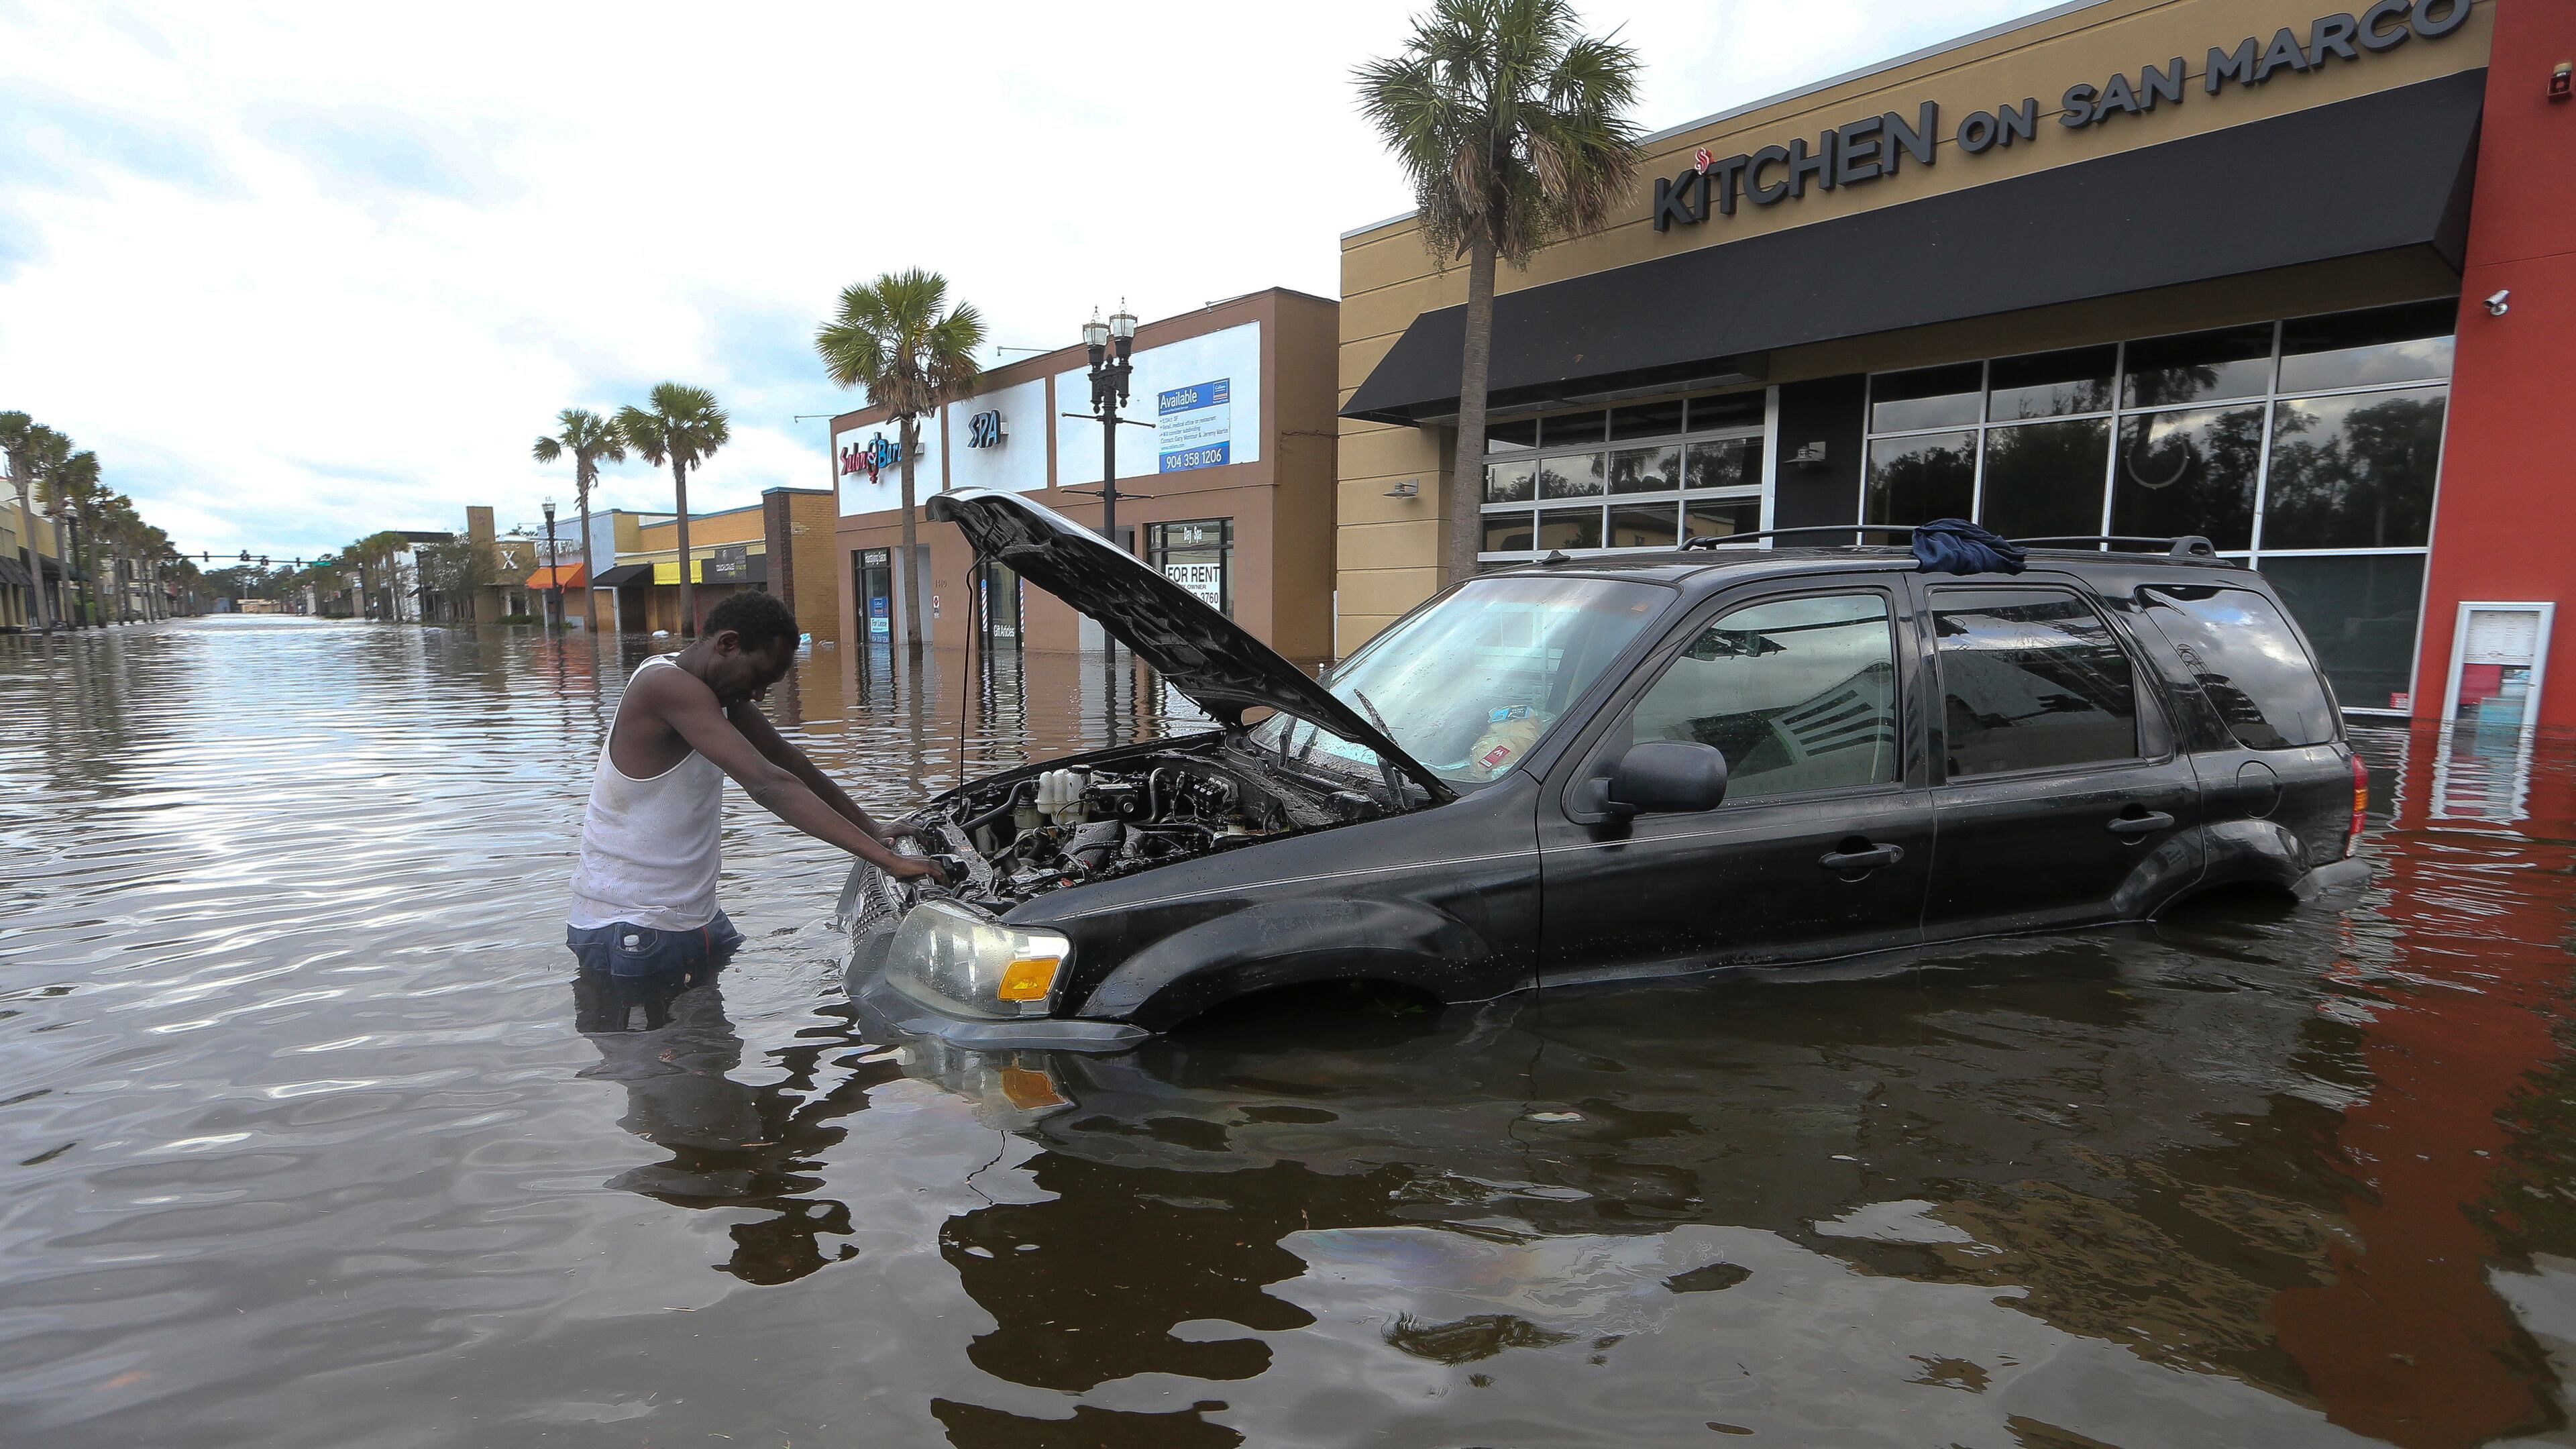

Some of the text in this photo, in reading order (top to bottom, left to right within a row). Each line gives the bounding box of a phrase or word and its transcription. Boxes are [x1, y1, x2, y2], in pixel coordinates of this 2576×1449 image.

[1957, 97, 2038, 154] ON
[2058, 56, 2186, 129] SAN
[2204, 0, 2471, 95] MARCO
[1160, 388, 1197, 409] Available
[967, 410, 1000, 448] SPA
[1166, 447, 1222, 470] 904 358 1206
[1167, 566, 1220, 583] FOR RENT
